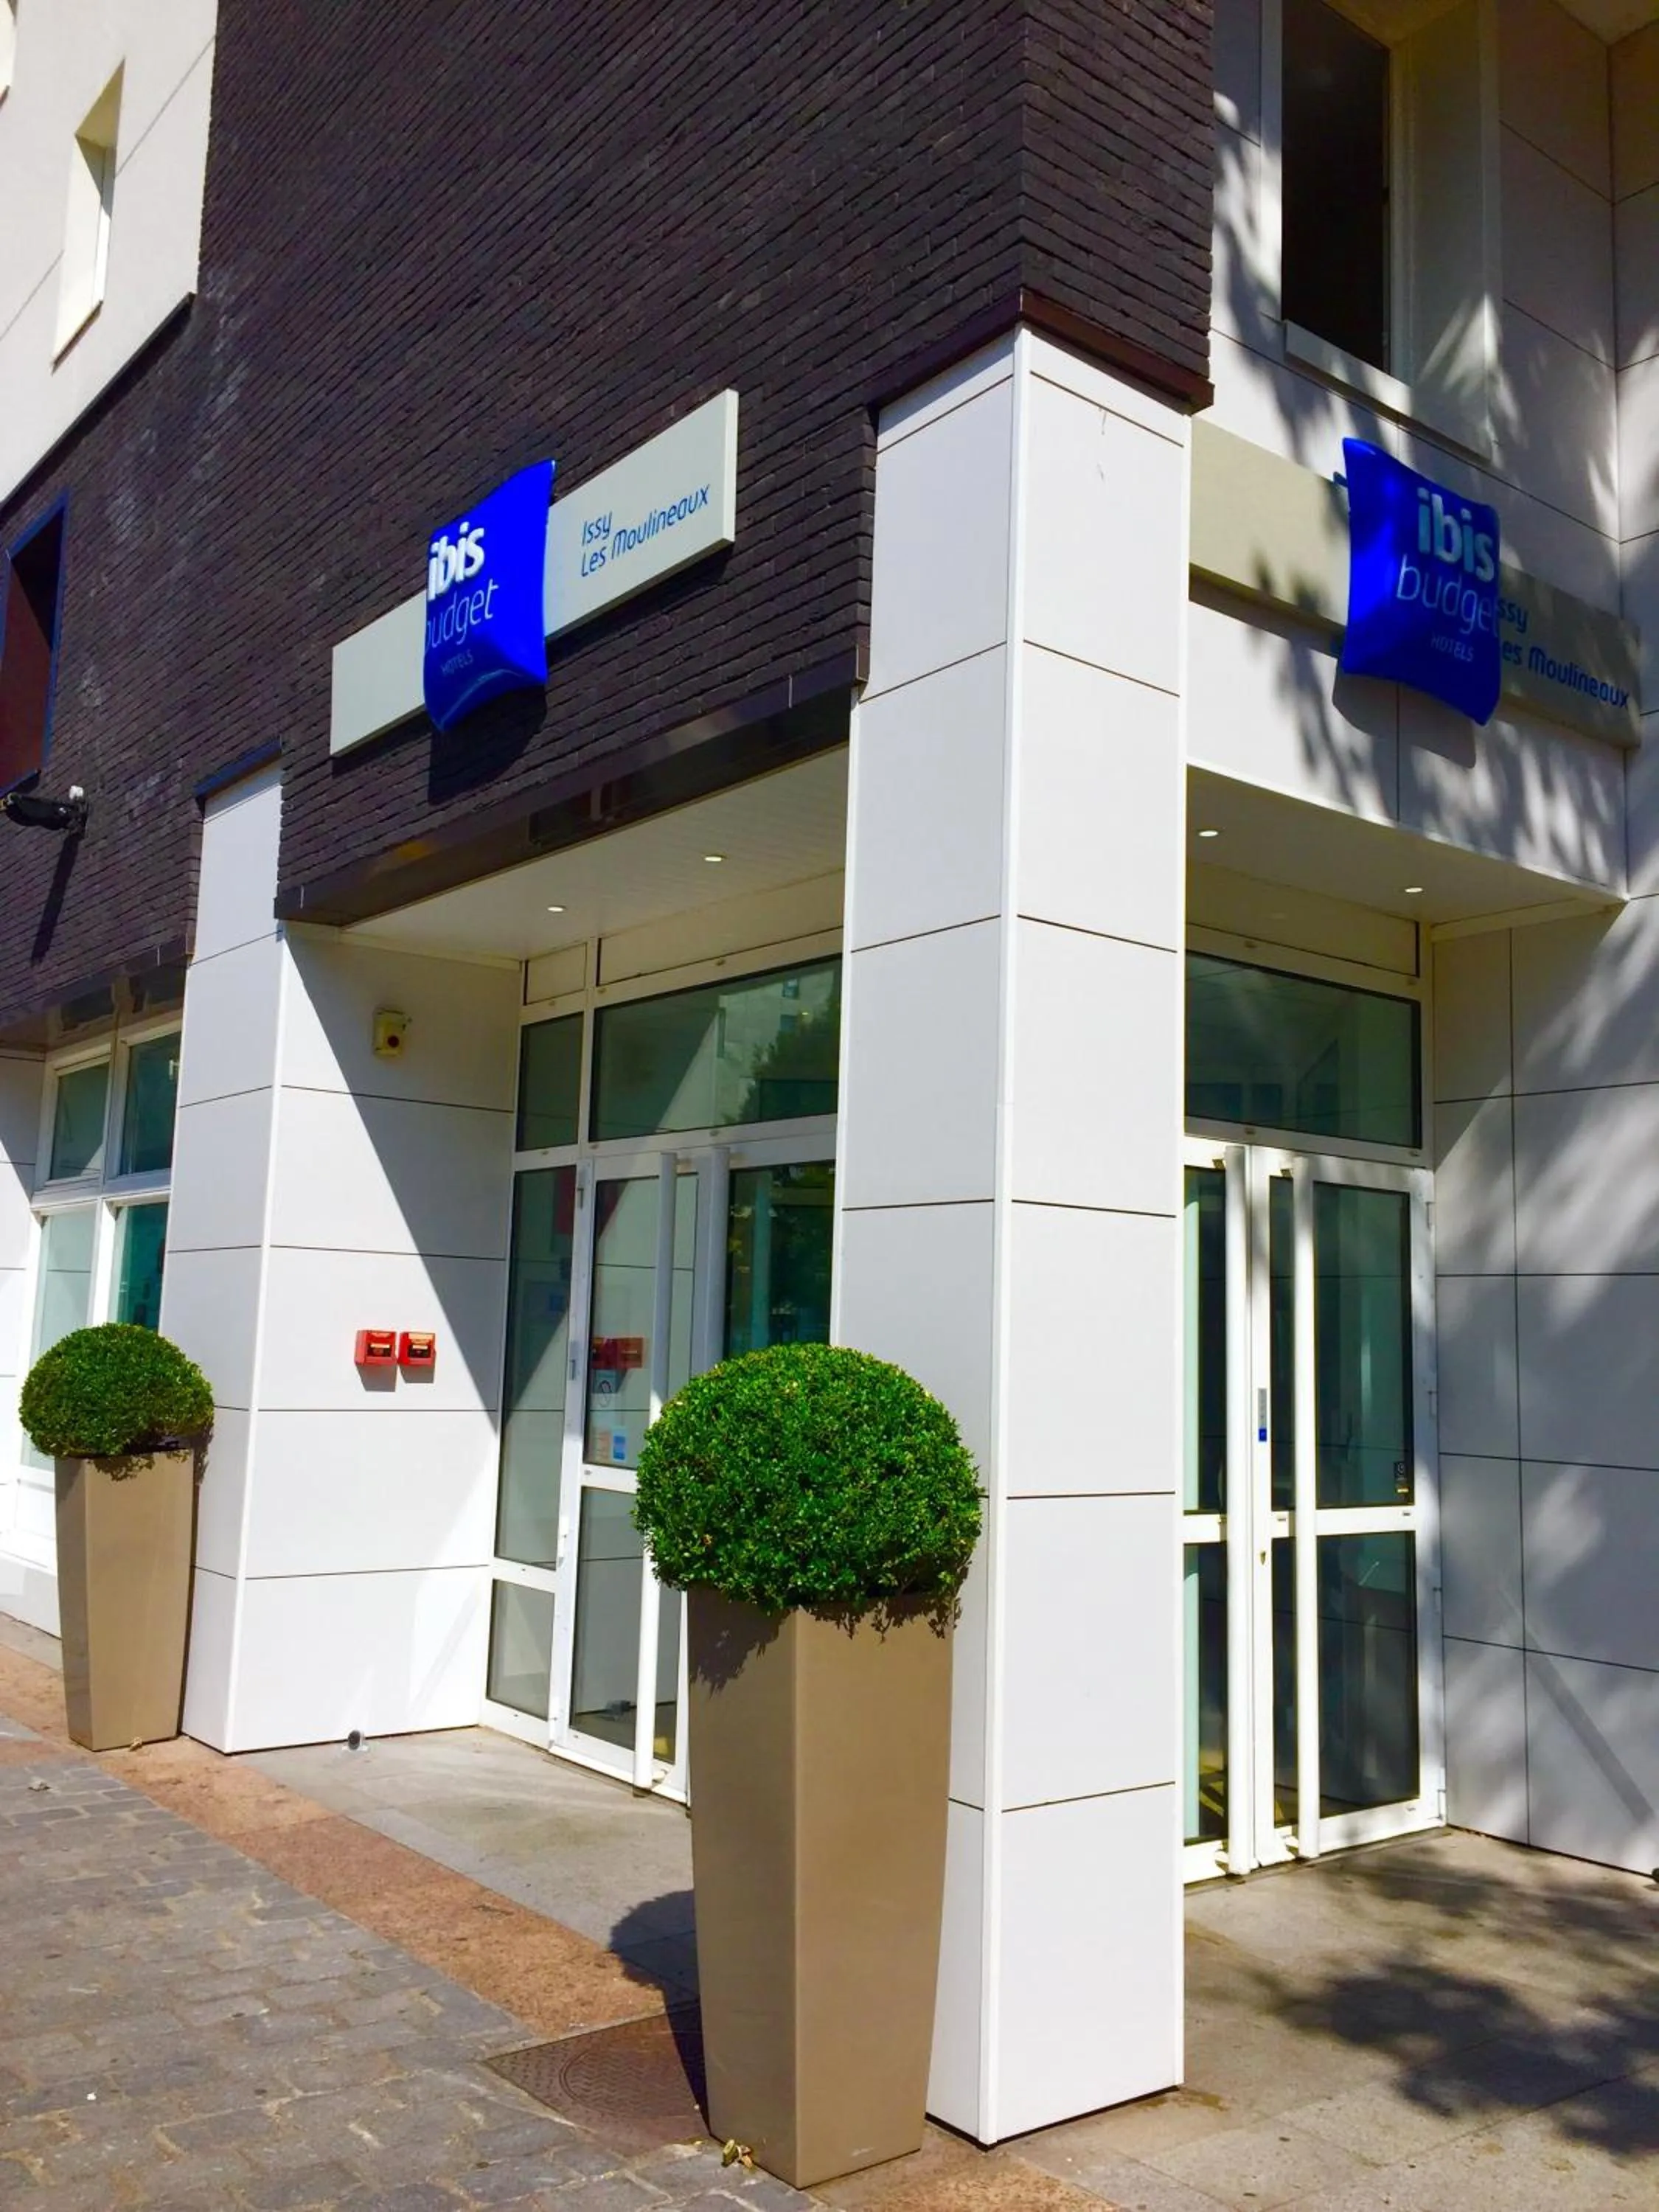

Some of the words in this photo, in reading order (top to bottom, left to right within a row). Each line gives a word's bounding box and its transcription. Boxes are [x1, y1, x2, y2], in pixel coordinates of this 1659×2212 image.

[427, 521, 485, 602] ibis
[581, 551, 607, 577] Les
[611, 484, 710, 560] Moulineaux
[582, 511, 613, 546] Issy
[1416, 488, 1495, 582] ibis
[1396, 554, 1500, 638] budge
[1497, 598, 1528, 634] ssy
[440, 648, 473, 677] HOTELS
[1430, 631, 1474, 662] HOTELS
[1502, 640, 1523, 666] es
[1528, 645, 1630, 709] Moulineaux
